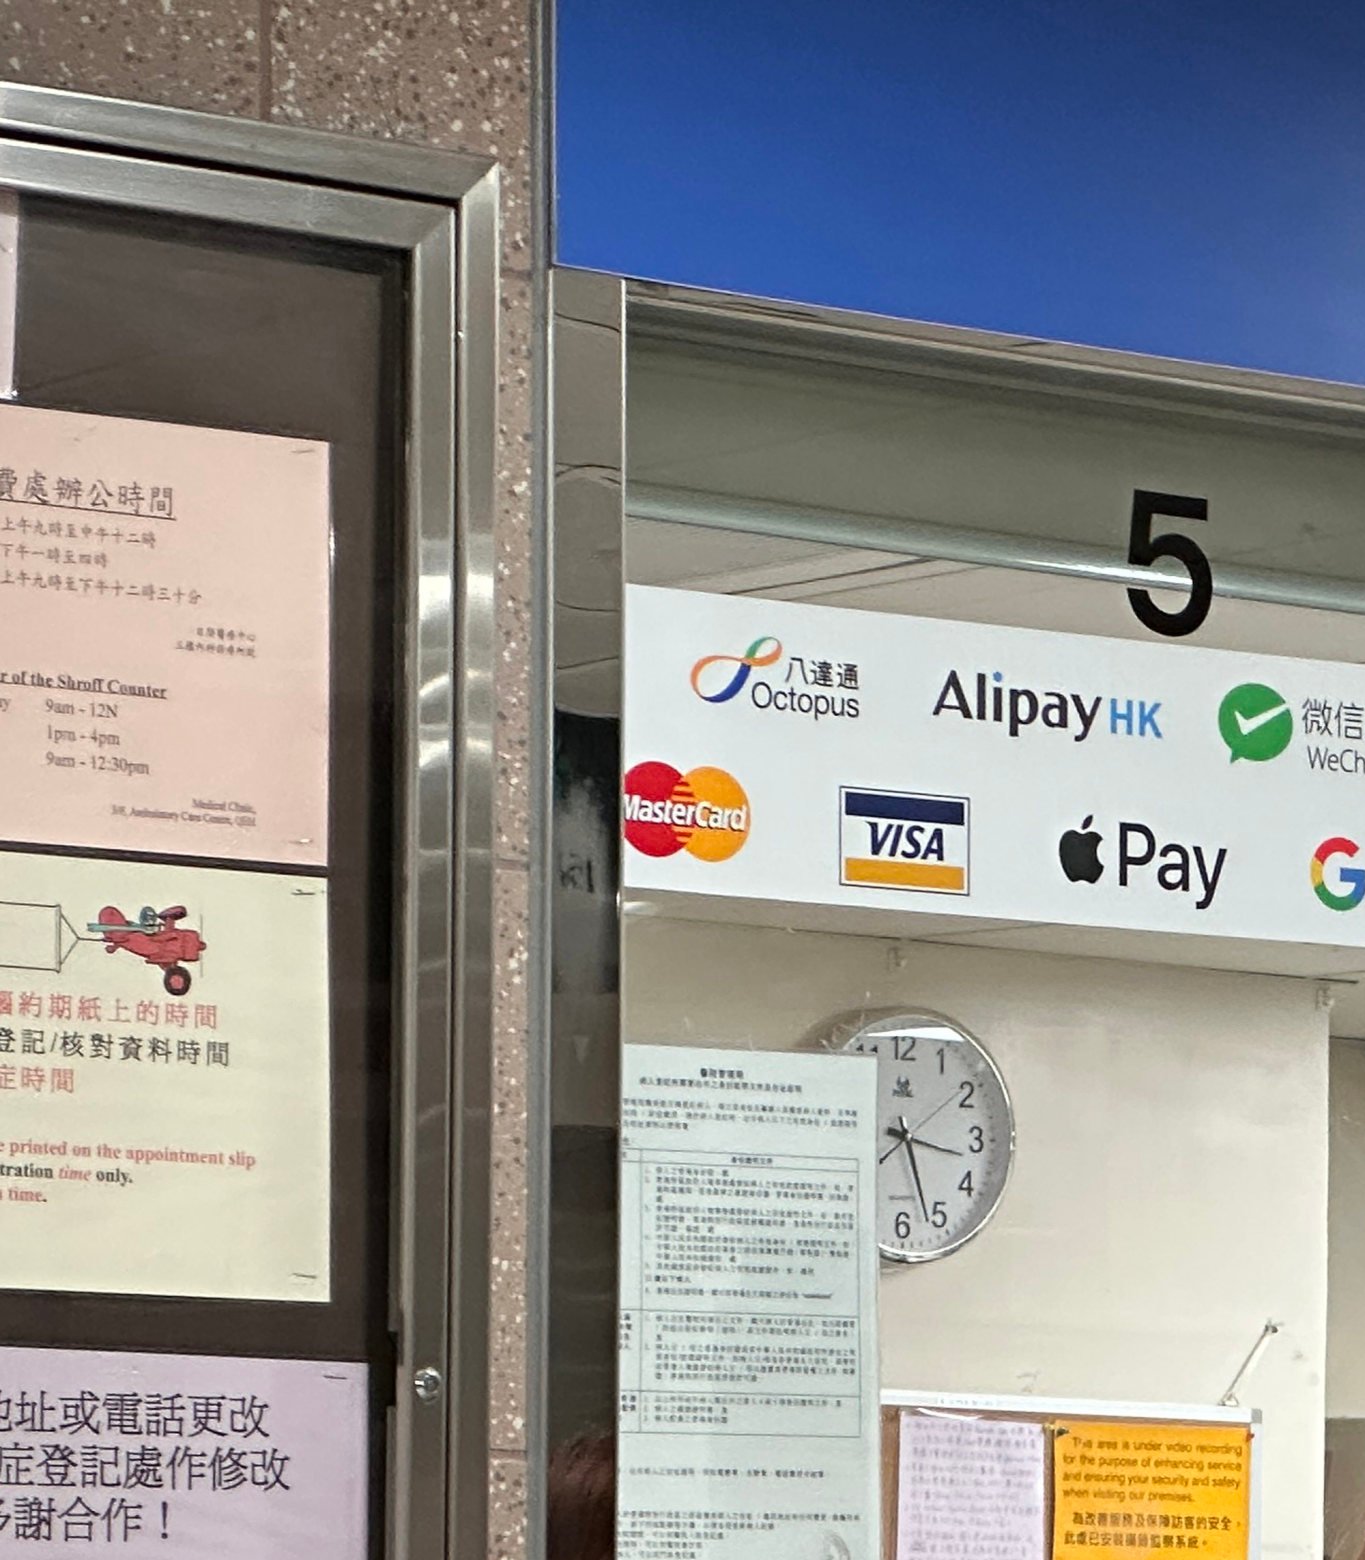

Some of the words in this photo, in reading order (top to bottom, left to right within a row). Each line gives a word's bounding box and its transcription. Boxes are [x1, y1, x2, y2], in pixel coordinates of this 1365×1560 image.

[1126, 488, 1213, 637] 5
[12, 671, 28, 685] of
[30, 672, 54, 688] the
[57, 674, 105, 693] Shroff
[107, 680, 168, 699] Counter
[784, 656, 860, 706] 八達通
[46, 699, 75, 715] 9am
[92, 703, 119, 719] 12N
[751, 680, 861, 737] Octopus
[931, 669, 1104, 742] Alipay
[1109, 697, 1166, 754] HK
[47, 725, 77, 744] 1pm
[91, 730, 120, 748] 4pm
[46, 752, 76, 769] 9am
[91, 757, 150, 777] 12:30pm
[625, 794, 747, 834] MasterCard
[866, 820, 944, 862] VISA
[1119, 822, 1227, 910] Pay
[891, 1036, 917, 1061] 12
[936, 1047, 944, 1075] 1
[958, 1081, 975, 1108] 2
[968, 1125, 984, 1153] 3
[10, 1139, 67, 1160] printed
[73, 1143, 91, 1156] on
[97, 1143, 121, 1160] the
[126, 1145, 223, 1166] appointment
[228, 1150, 257, 1171] slip
[957, 1170, 975, 1197] 4
[894, 1211, 911, 1239] 6
[931, 1201, 947, 1228] 5
[0, 1390, 270, 1438] 址或電話更改
[0, 1497, 168, 1542] 謝合作！
